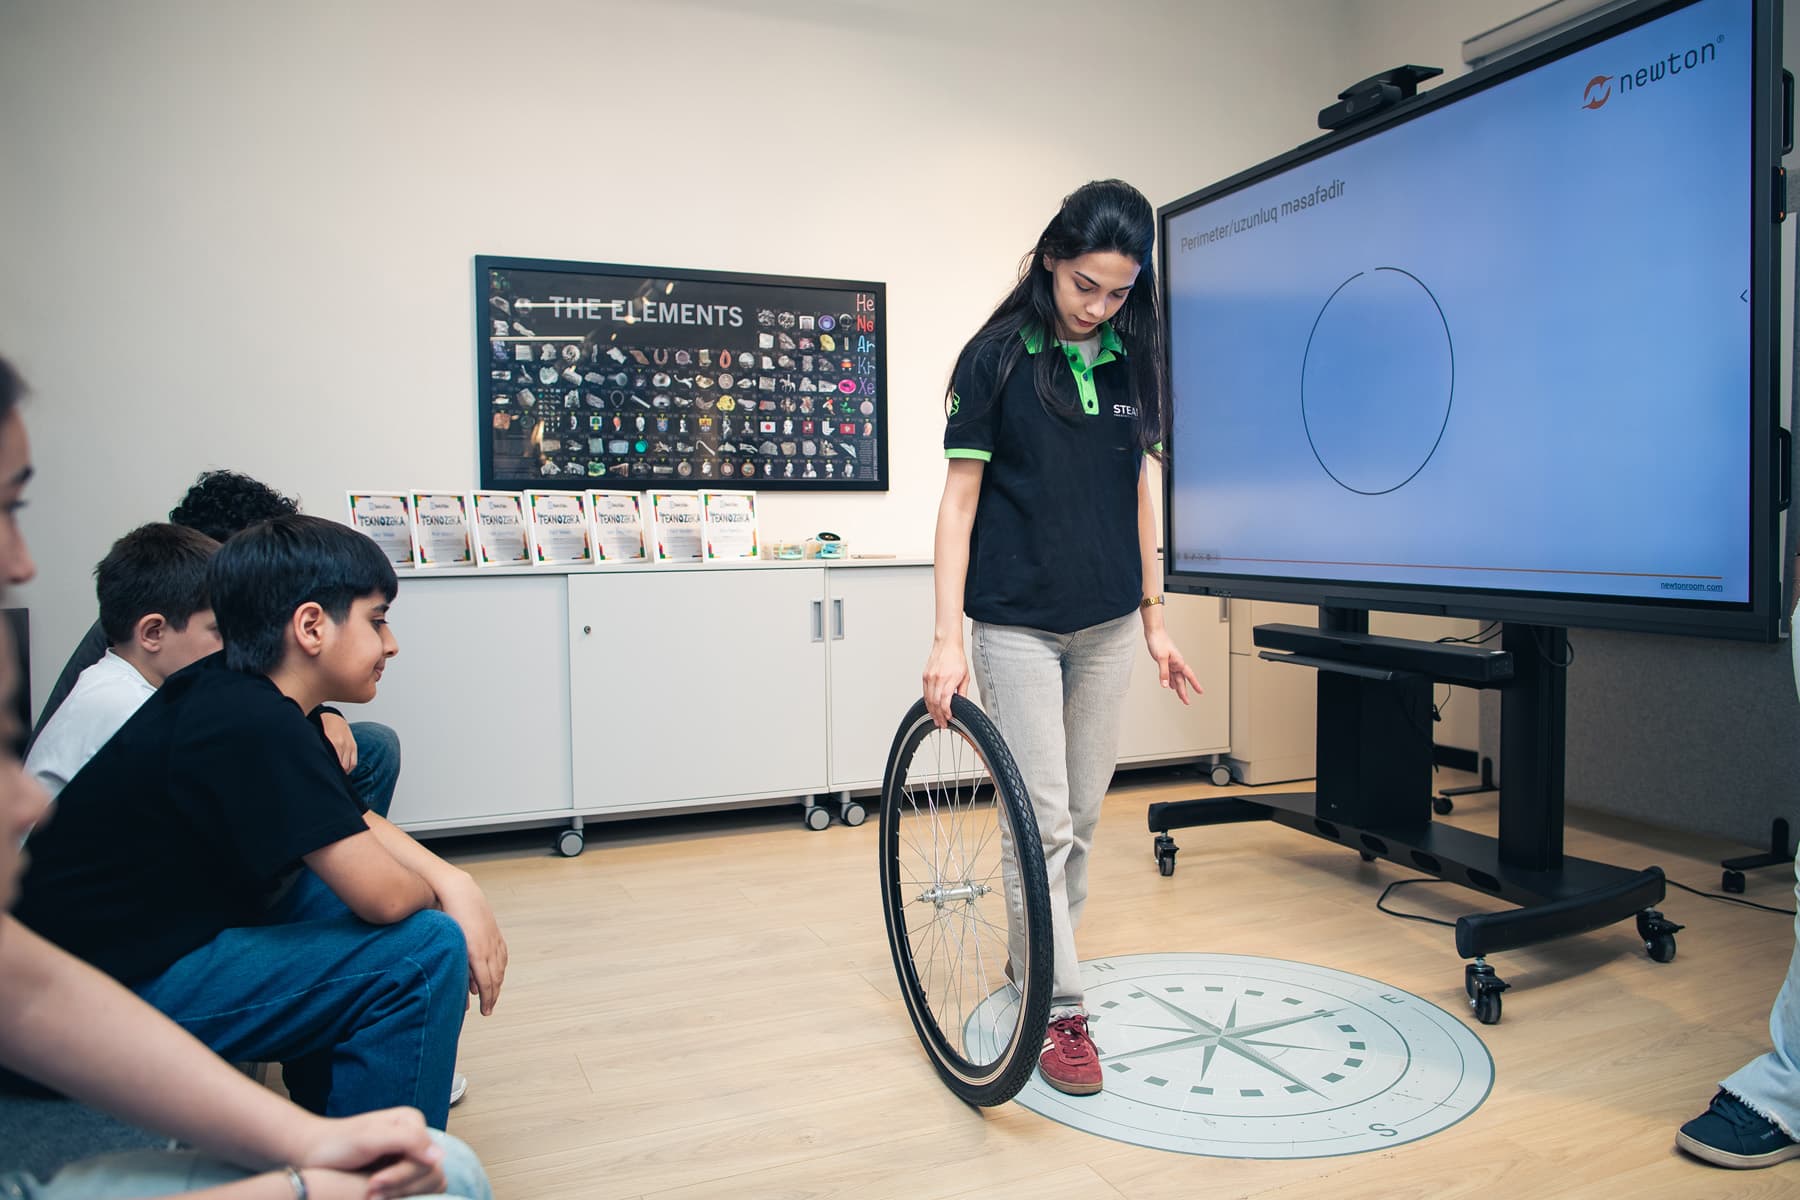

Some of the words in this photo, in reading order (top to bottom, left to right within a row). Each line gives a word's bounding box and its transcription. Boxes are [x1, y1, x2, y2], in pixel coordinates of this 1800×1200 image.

[1281, 179, 1346, 217] məsafədir
[548, 295, 602, 321] THE
[611, 299, 744, 328] ELEMENTS
[855, 292, 876, 312] He
[855, 314, 875, 333] Ne
[857, 335, 876, 353] Ar
[857, 355, 876, 375] Kr
[858, 376, 876, 396] Xe
[1660, 582, 1723, 593] newtonroom.com
[1091, 961, 1116, 973] N
[1379, 993, 1405, 1004] E
[1368, 1122, 1399, 1138] S
